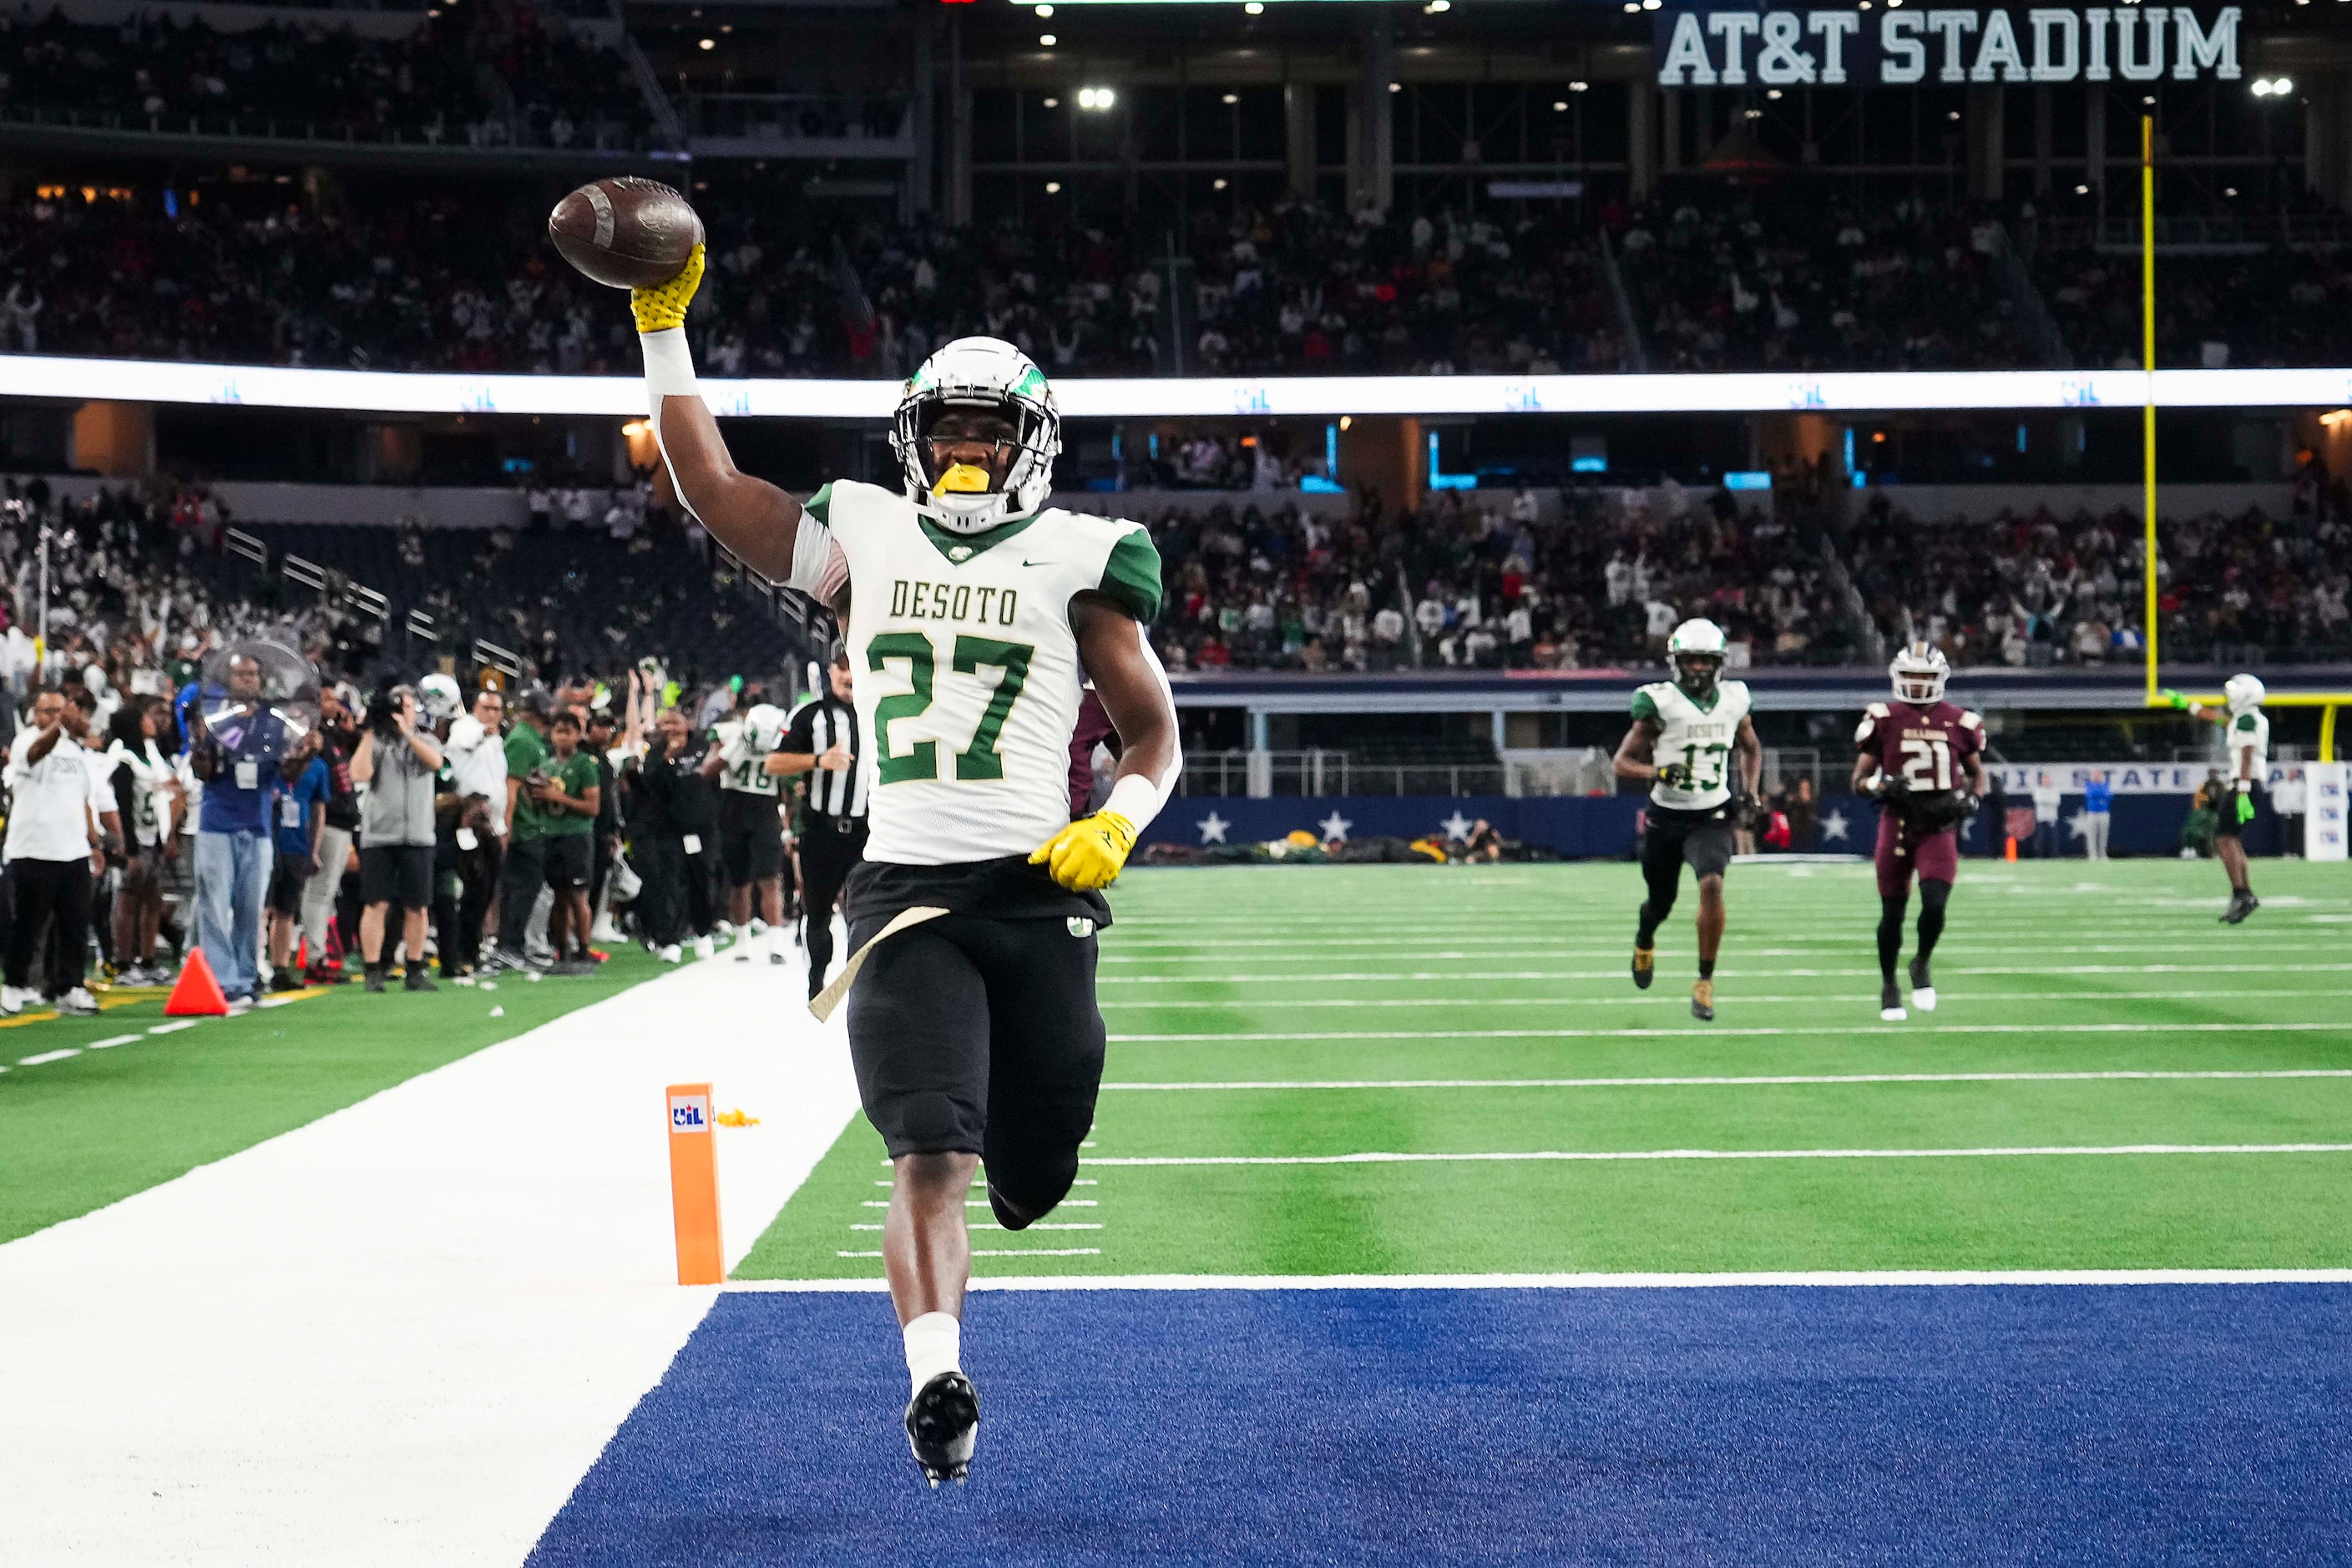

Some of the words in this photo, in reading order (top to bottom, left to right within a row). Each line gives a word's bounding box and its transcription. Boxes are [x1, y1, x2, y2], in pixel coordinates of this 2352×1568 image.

[1658, 12, 1859, 84] AT&T
[1881, 7, 2242, 83] STADIUM
[889, 579, 1018, 626] DESOTO
[865, 630, 1037, 787] 27
[1679, 741, 1728, 792] 13
[1899, 739, 1952, 792] 21
